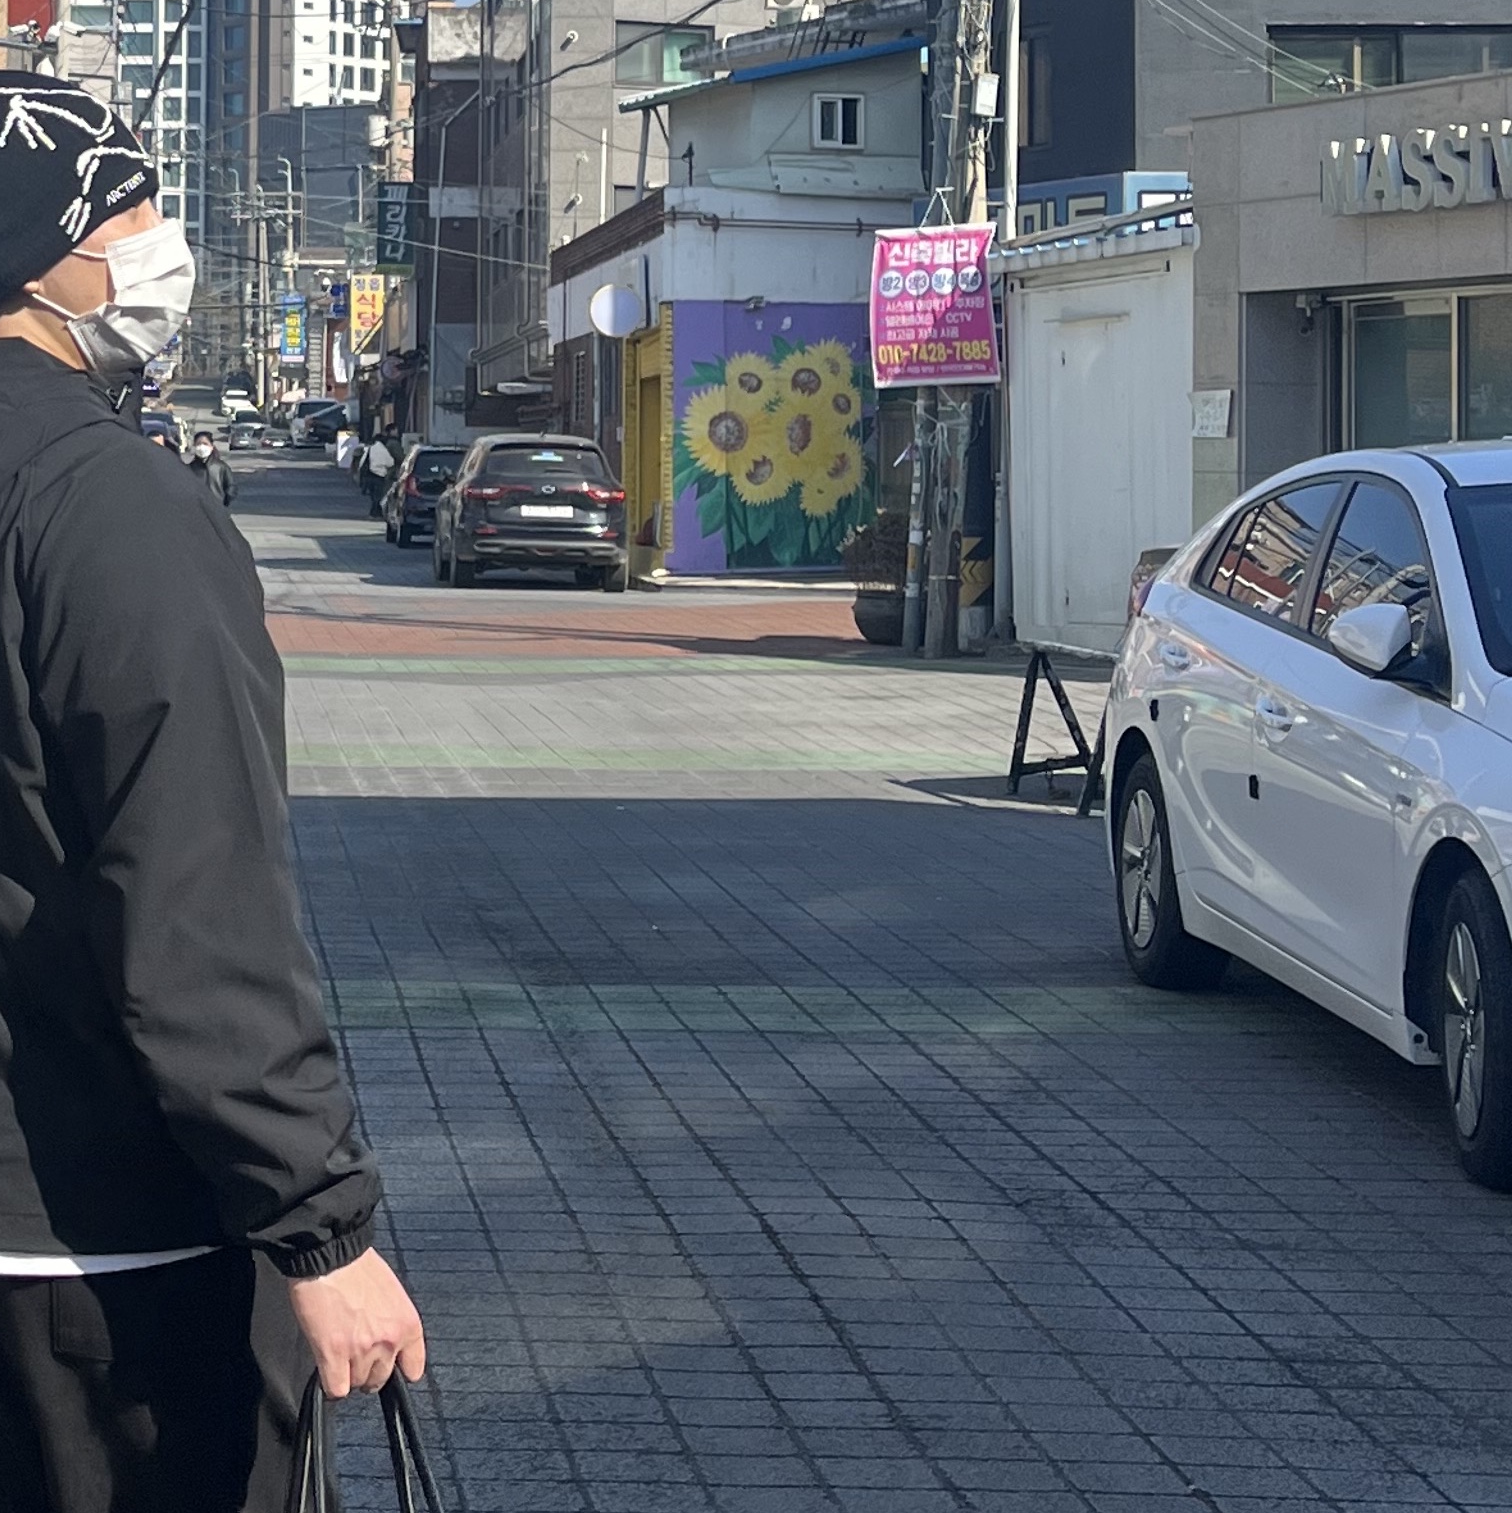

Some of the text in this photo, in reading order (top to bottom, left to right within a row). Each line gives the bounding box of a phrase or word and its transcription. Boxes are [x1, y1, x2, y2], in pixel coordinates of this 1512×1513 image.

[888, 238, 978, 266] 신축빌라
[945, 312, 972, 324] CCTV
[878, 341, 991, 364] 010-7428-7885
